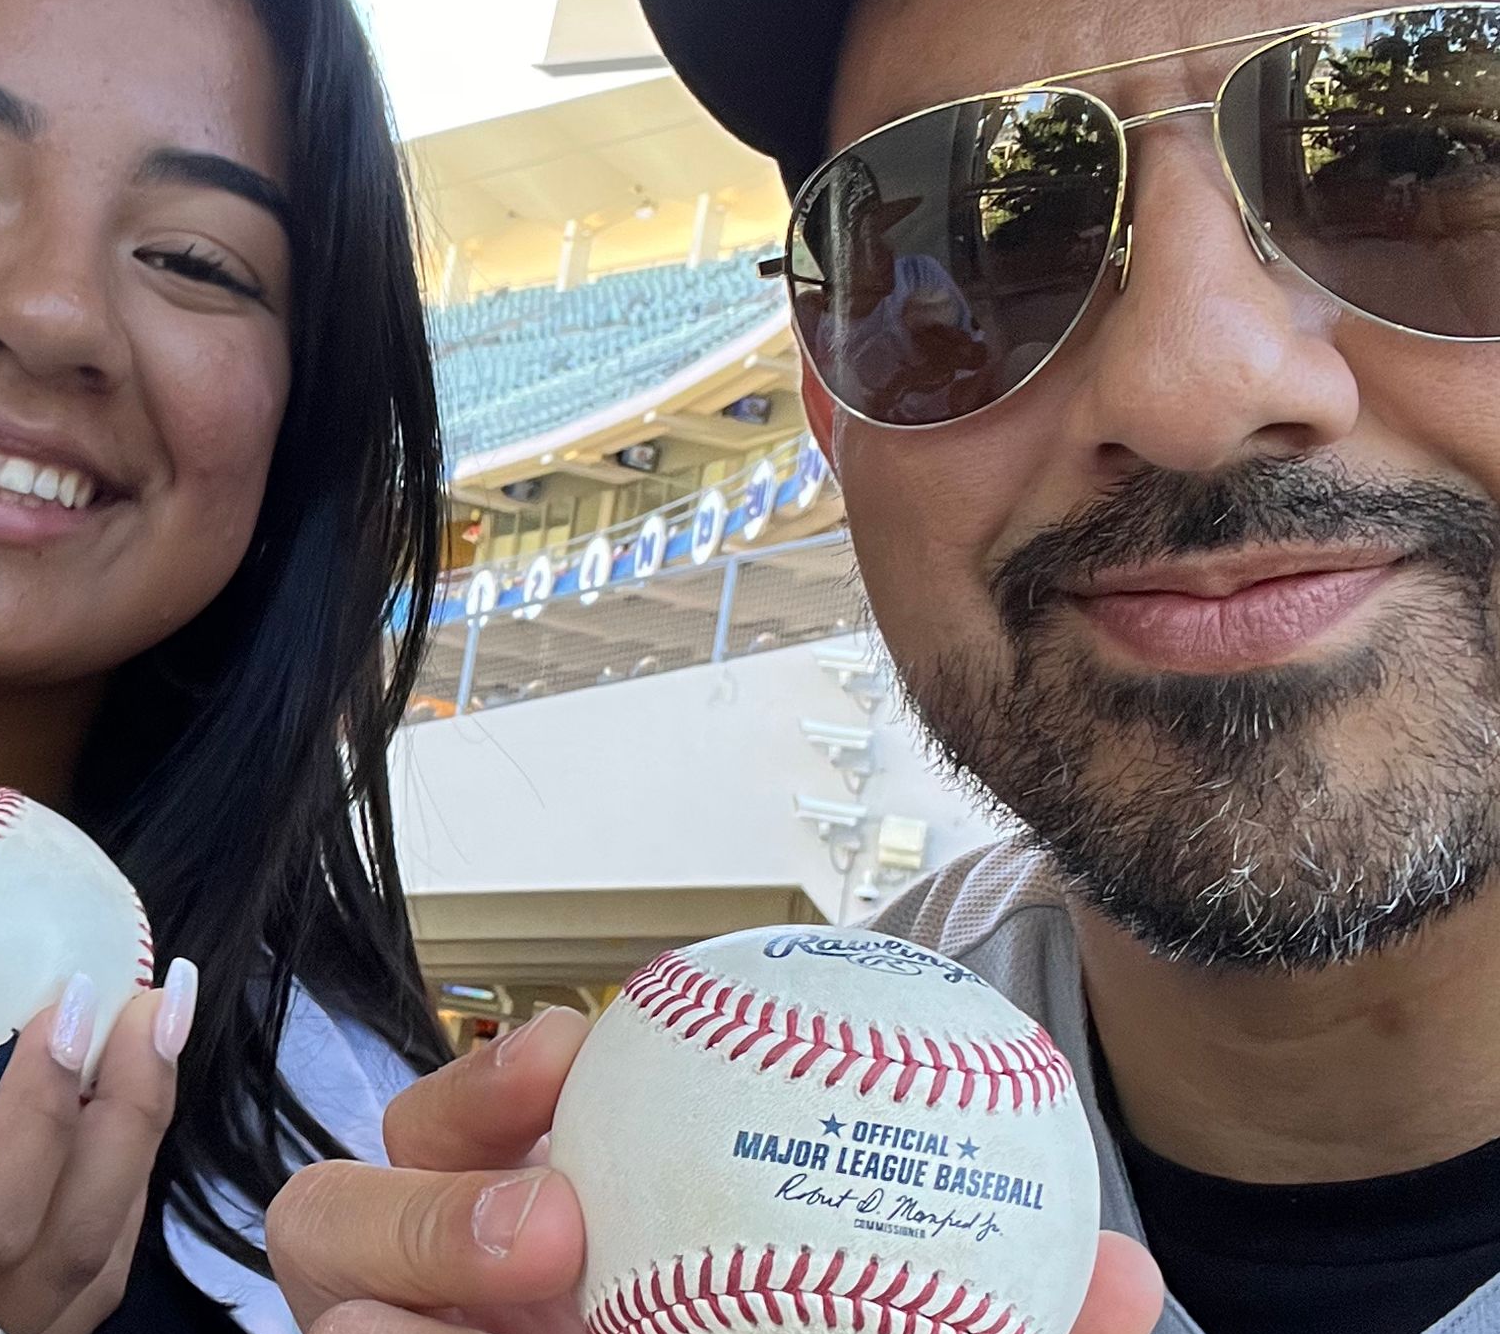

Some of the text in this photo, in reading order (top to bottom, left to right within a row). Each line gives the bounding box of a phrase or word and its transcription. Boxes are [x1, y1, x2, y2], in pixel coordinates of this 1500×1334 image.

[851, 1119, 950, 1157] OFFICIAL
[732, 1130, 1045, 1210] MAJOR LEAGUE BASEBALL
[853, 1218, 928, 1239] COMMISSIONER
